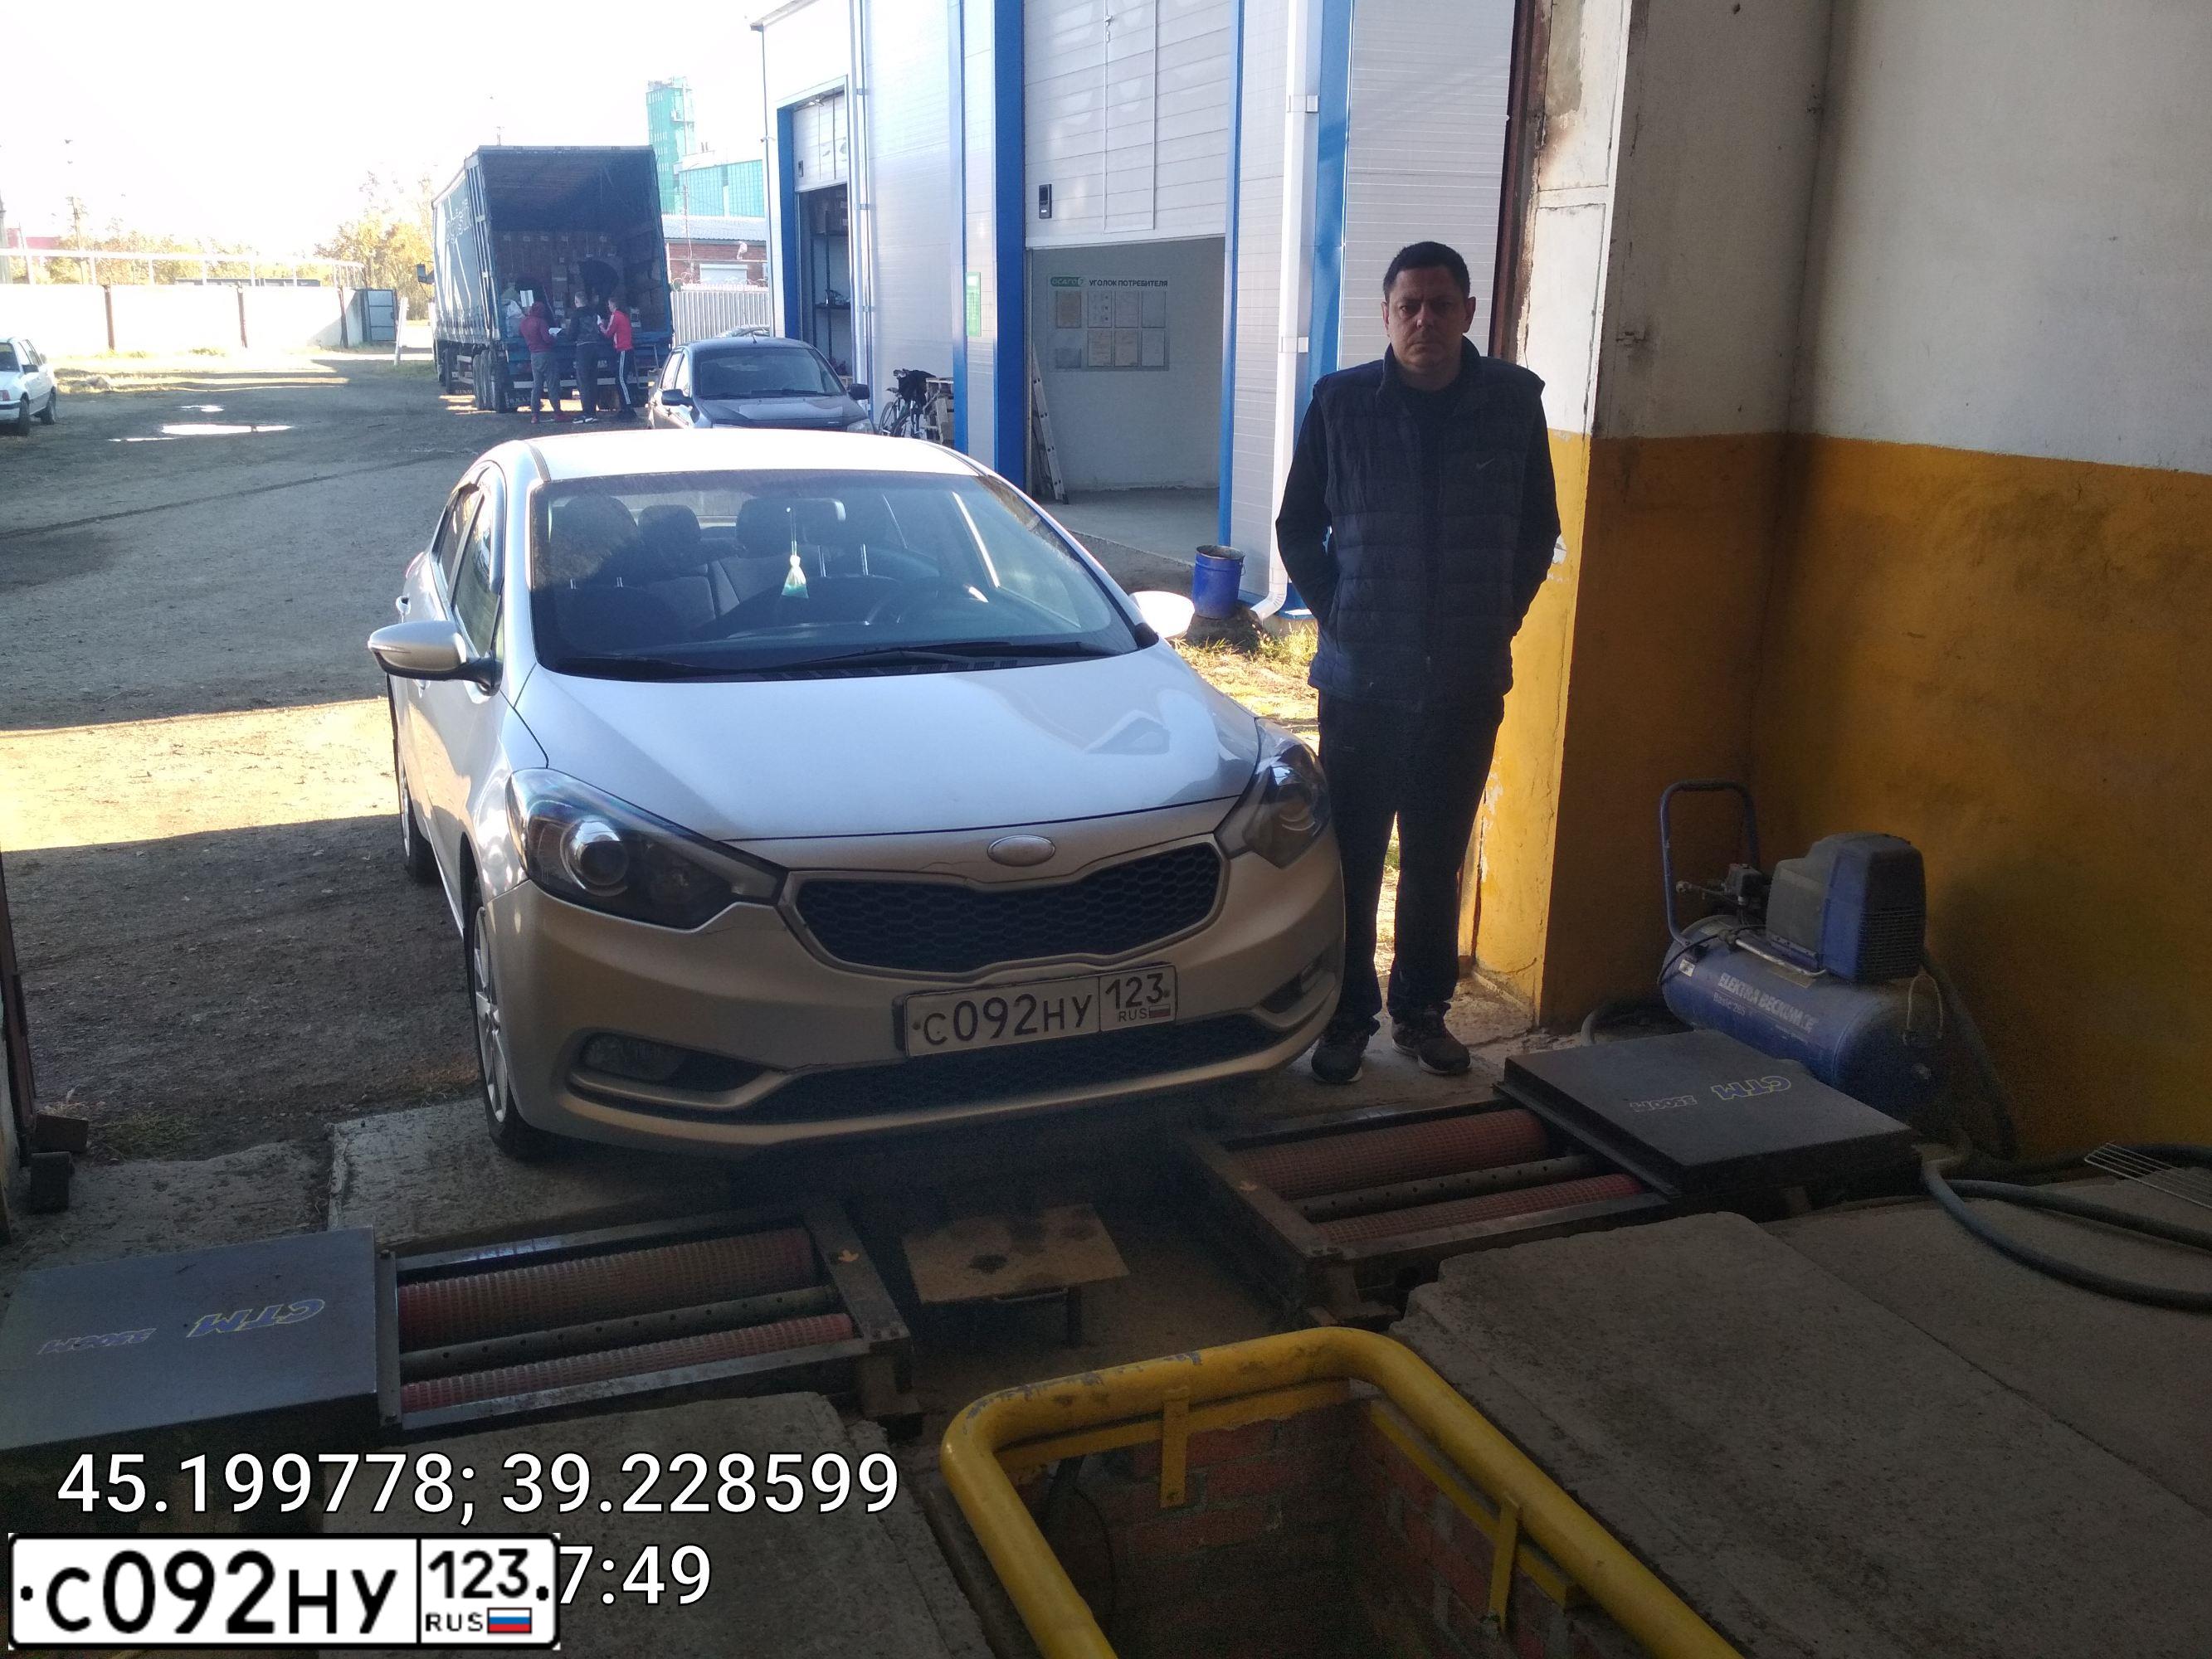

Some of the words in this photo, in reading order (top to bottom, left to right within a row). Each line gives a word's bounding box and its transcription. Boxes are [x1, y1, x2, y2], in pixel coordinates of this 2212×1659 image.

[1089, 279, 1116, 287] УГОЛОК
[1118, 280, 1168, 288] ПОТРЕБИТЕЛЯ
[1105, 973, 1163, 1010] 123
[1118, 1007, 1148, 1022] RUS
